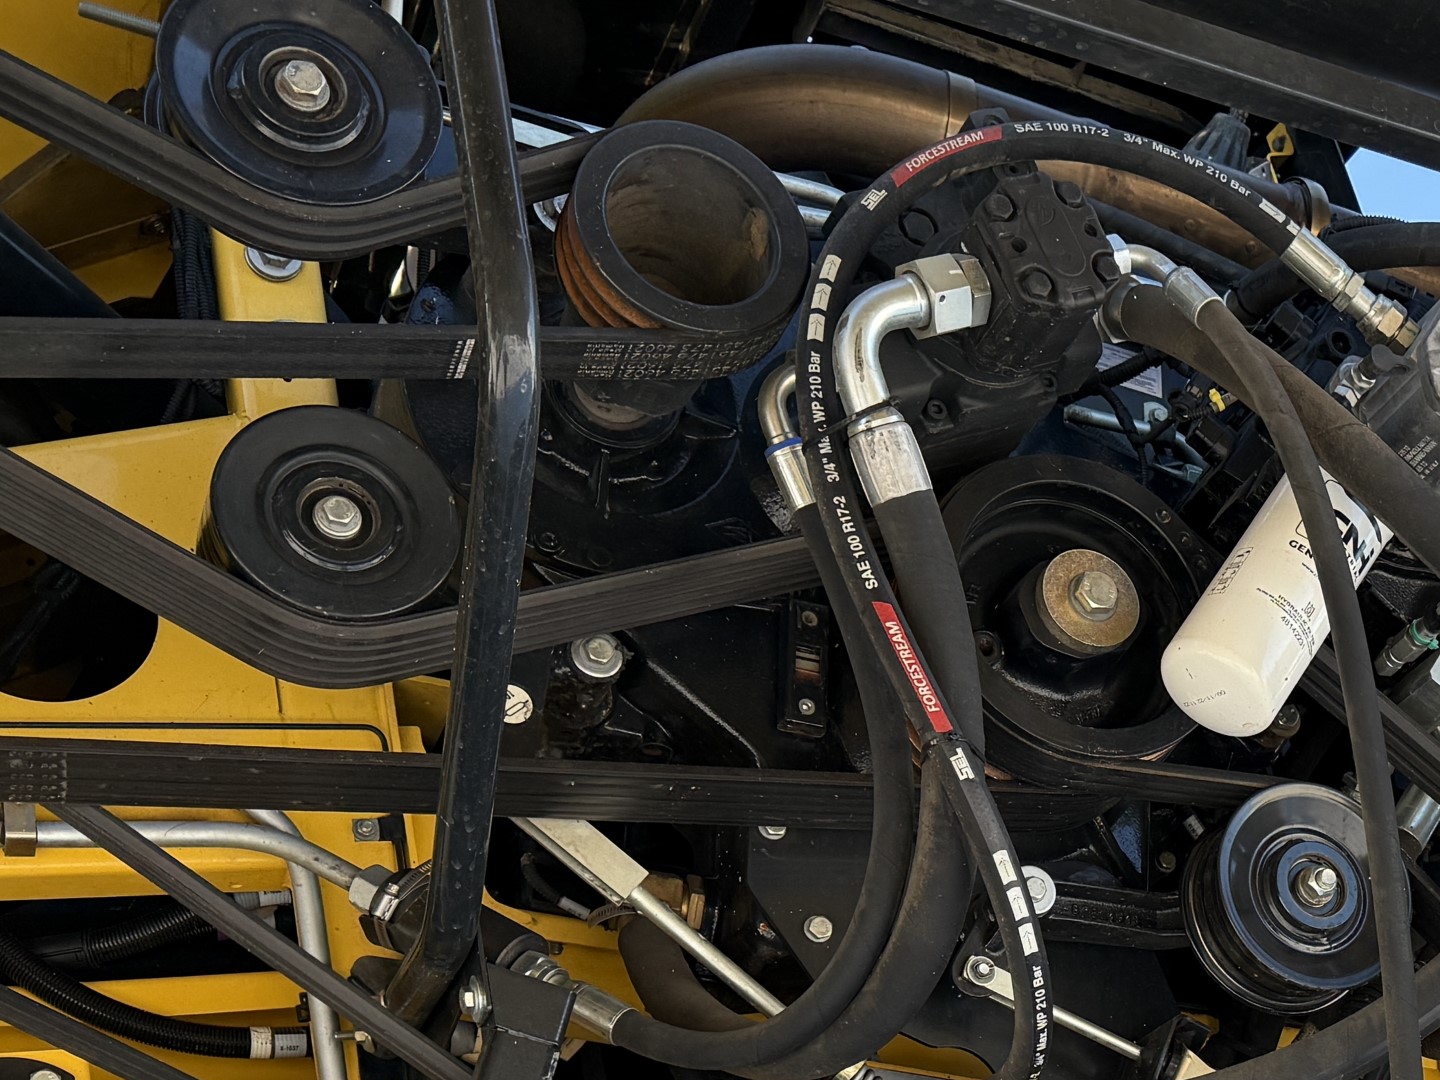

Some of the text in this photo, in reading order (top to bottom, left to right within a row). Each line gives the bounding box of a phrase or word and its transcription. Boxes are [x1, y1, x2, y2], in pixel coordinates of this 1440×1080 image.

[905, 130, 984, 172] FORCESTREAM
[1014, 123, 1043, 134] SAE
[1047, 122, 1069, 133] 100
[1072, 124, 1110, 138] R17-2
[1152, 141, 1181, 161] Max.
[1183, 153, 1204, 168] WP
[1206, 165, 1228, 183] 210
[1230, 179, 1251, 198] Bar
[808, 351, 821, 373] Bar
[809, 376, 823, 399] 210
[812, 401, 827, 423] WP
[822, 457, 840, 482] 3/4"
[833, 496, 853, 534] R17-2
[847, 535, 865, 558] 100
[856, 561, 879, 590] SAE
[885, 621, 940, 713] FORCESTREAM
[1032, 965, 1045, 987] Bar
[1034, 989, 1047, 1010] 210
[1036, 1012, 1048, 1030] WP
